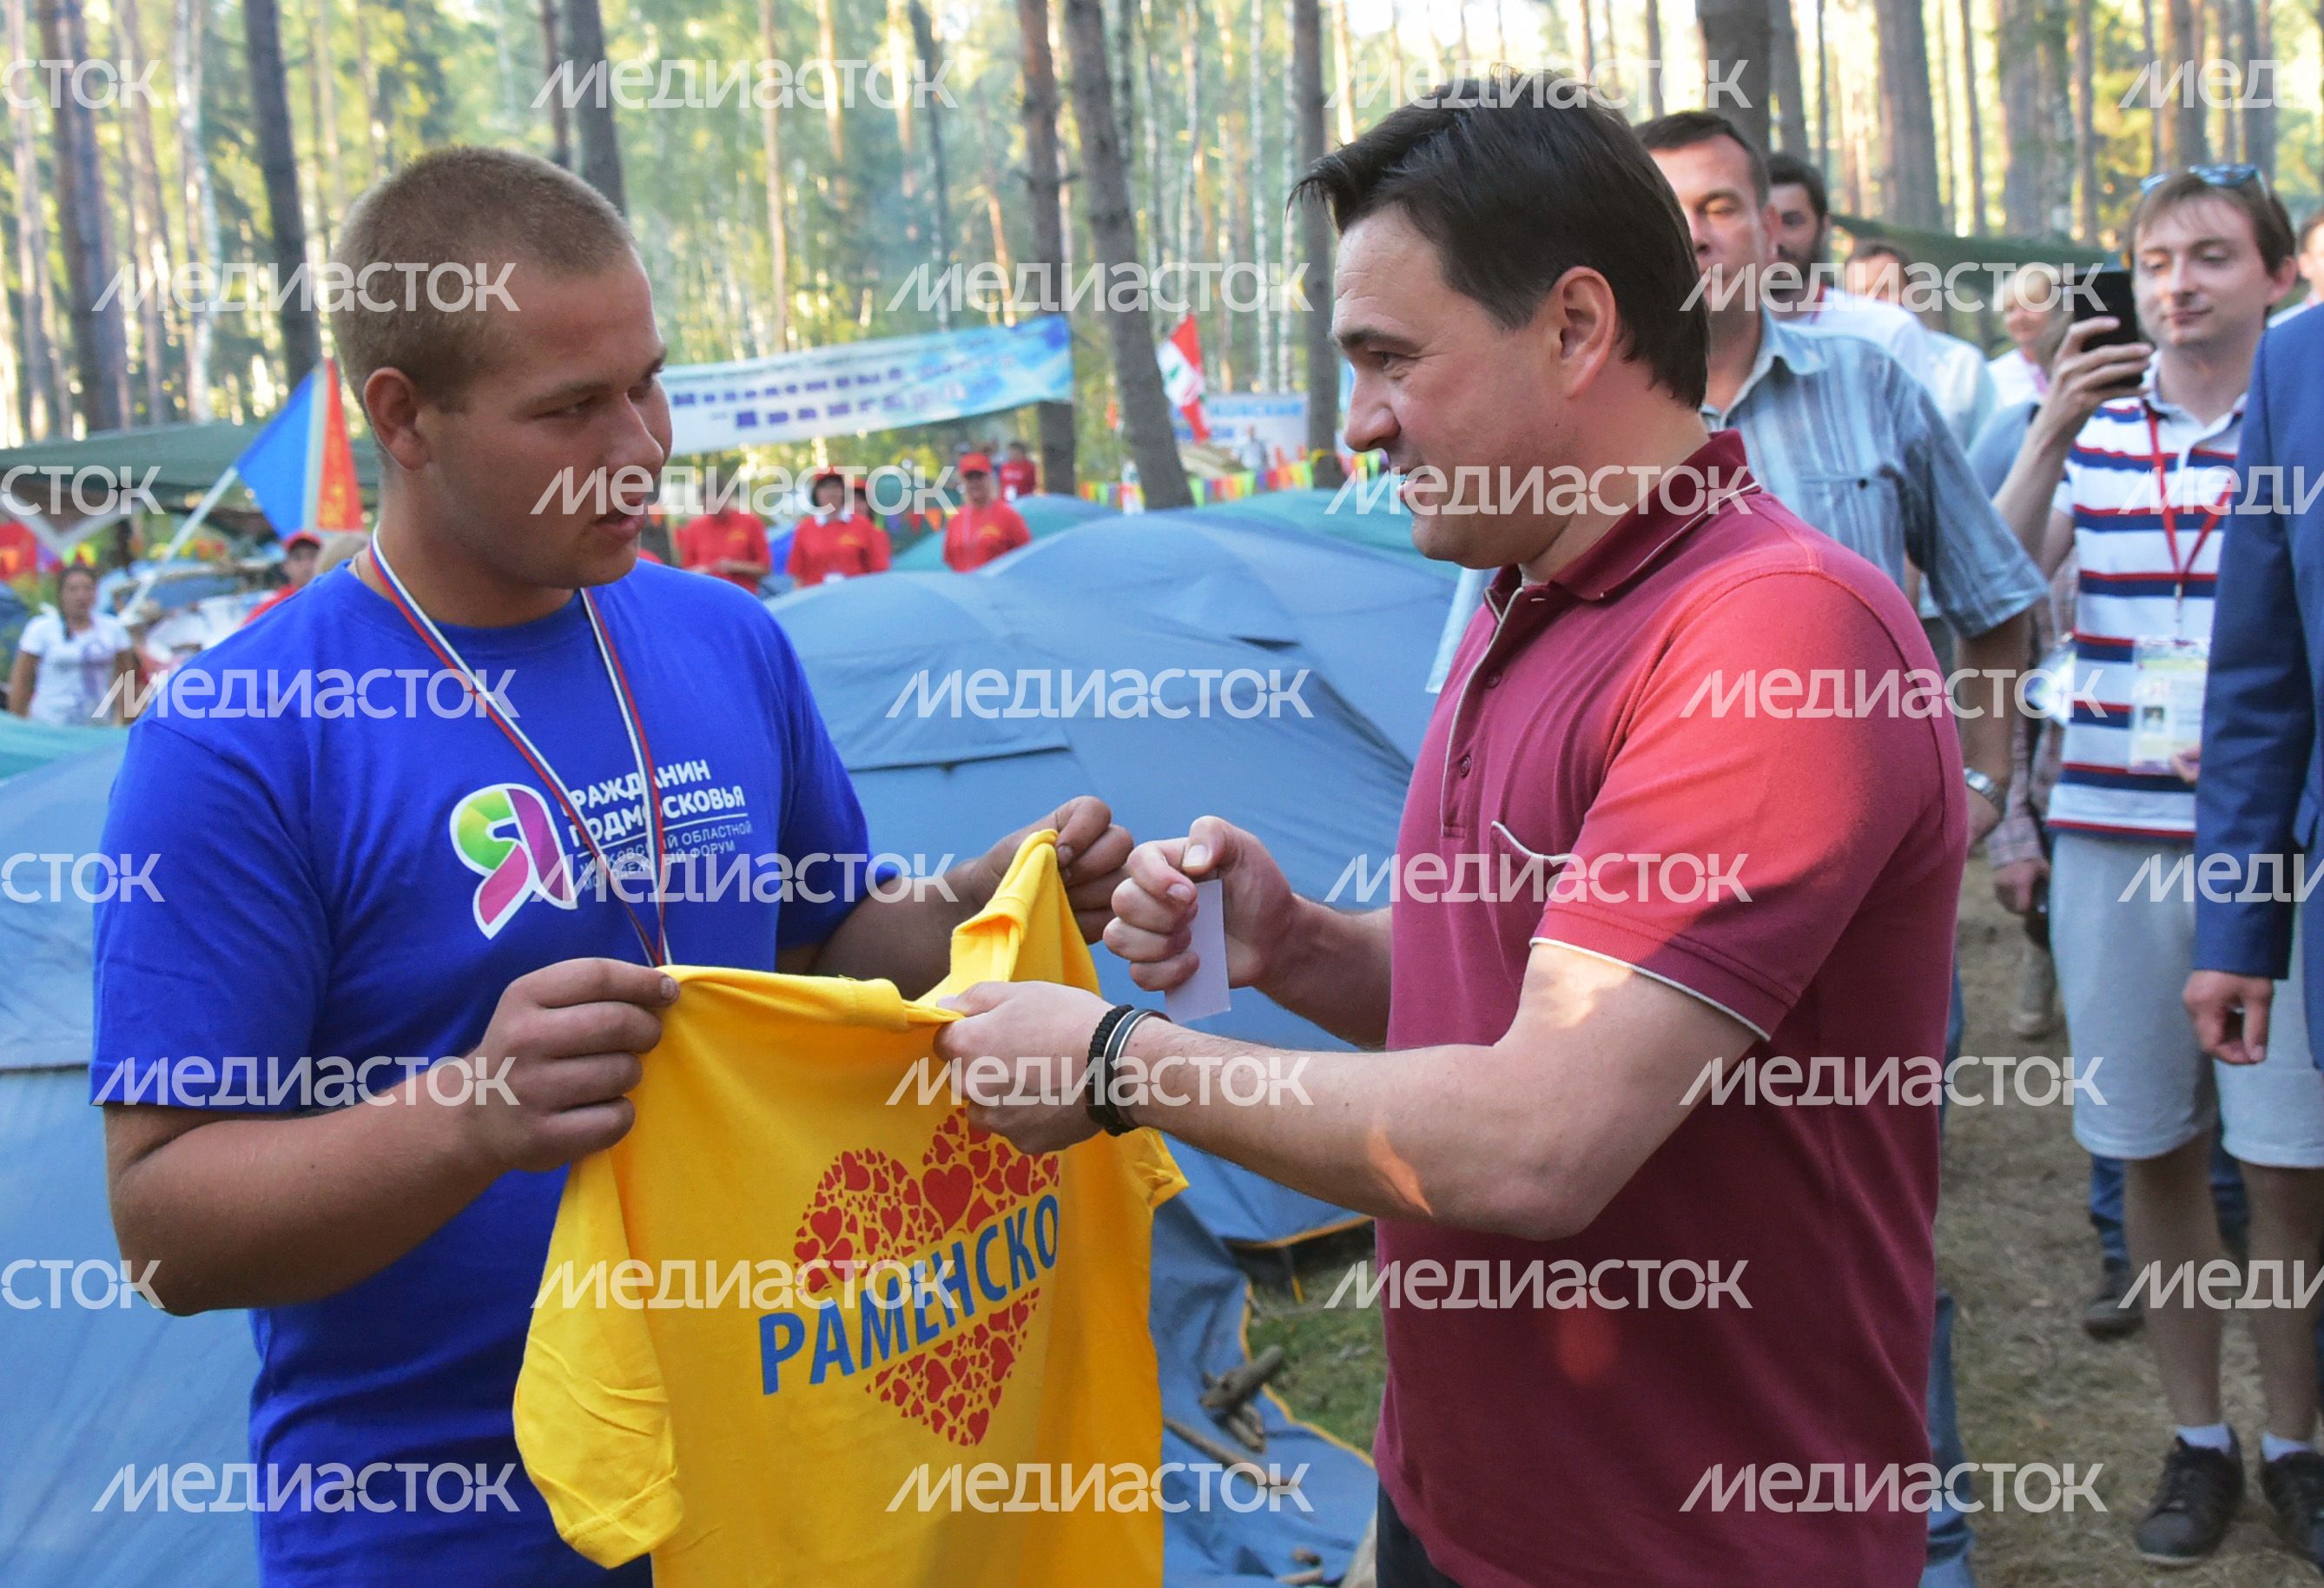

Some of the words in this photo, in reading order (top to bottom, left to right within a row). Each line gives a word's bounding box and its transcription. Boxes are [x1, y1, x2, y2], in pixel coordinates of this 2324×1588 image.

[560, 759, 711, 817] РАЖДНИН
[681, 820, 754, 846] ОБЛАСТНОЙ
[690, 840, 737, 859] ФОРУМ
[758, 1194, 1059, 1396] РАМЕНСКО
